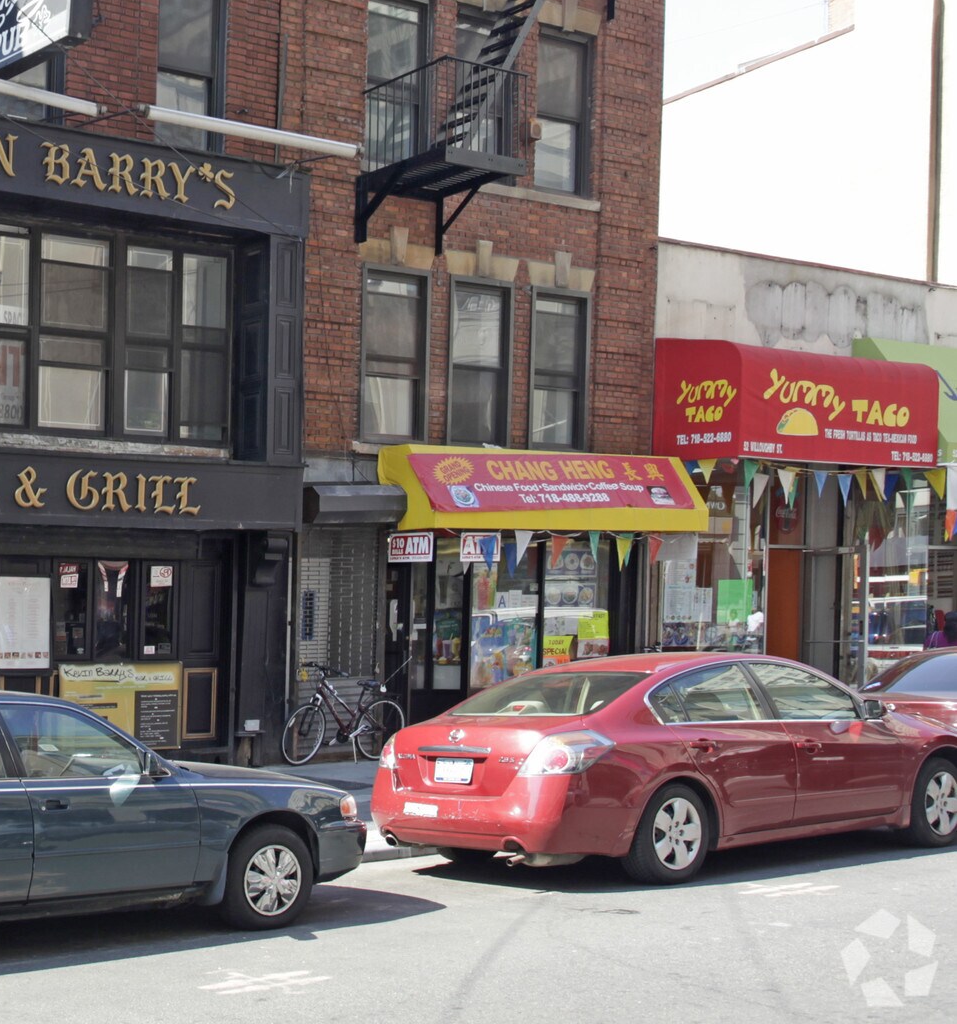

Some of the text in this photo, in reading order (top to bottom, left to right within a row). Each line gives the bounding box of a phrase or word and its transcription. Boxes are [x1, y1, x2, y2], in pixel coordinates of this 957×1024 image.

[685, 405, 724, 423] TACO
[851, 399, 910, 428] TACO
[676, 434, 689, 445] TEL:
[833, 429, 846, 440] FRESH
[846, 430, 866, 441] TORTILLAS
[907, 434, 917, 444] FOOD
[750, 441, 775, 454] WILLOUGHBY
[891, 450, 901, 461] TEL:
[486, 460, 613, 481] CHANG HENG
[14, 466, 47, 509] &
[67, 468, 200, 516] GRILL
[474, 482, 514, 493] Chinese
[619, 482, 644, 493] Soup
[521, 493, 610, 503] Tel: 718-488-9288
[392, 538, 404, 548] $10
[405, 537, 429, 554] ATM
[498, 596, 506, 608] A
[543, 647, 567, 656] SPECIAL
